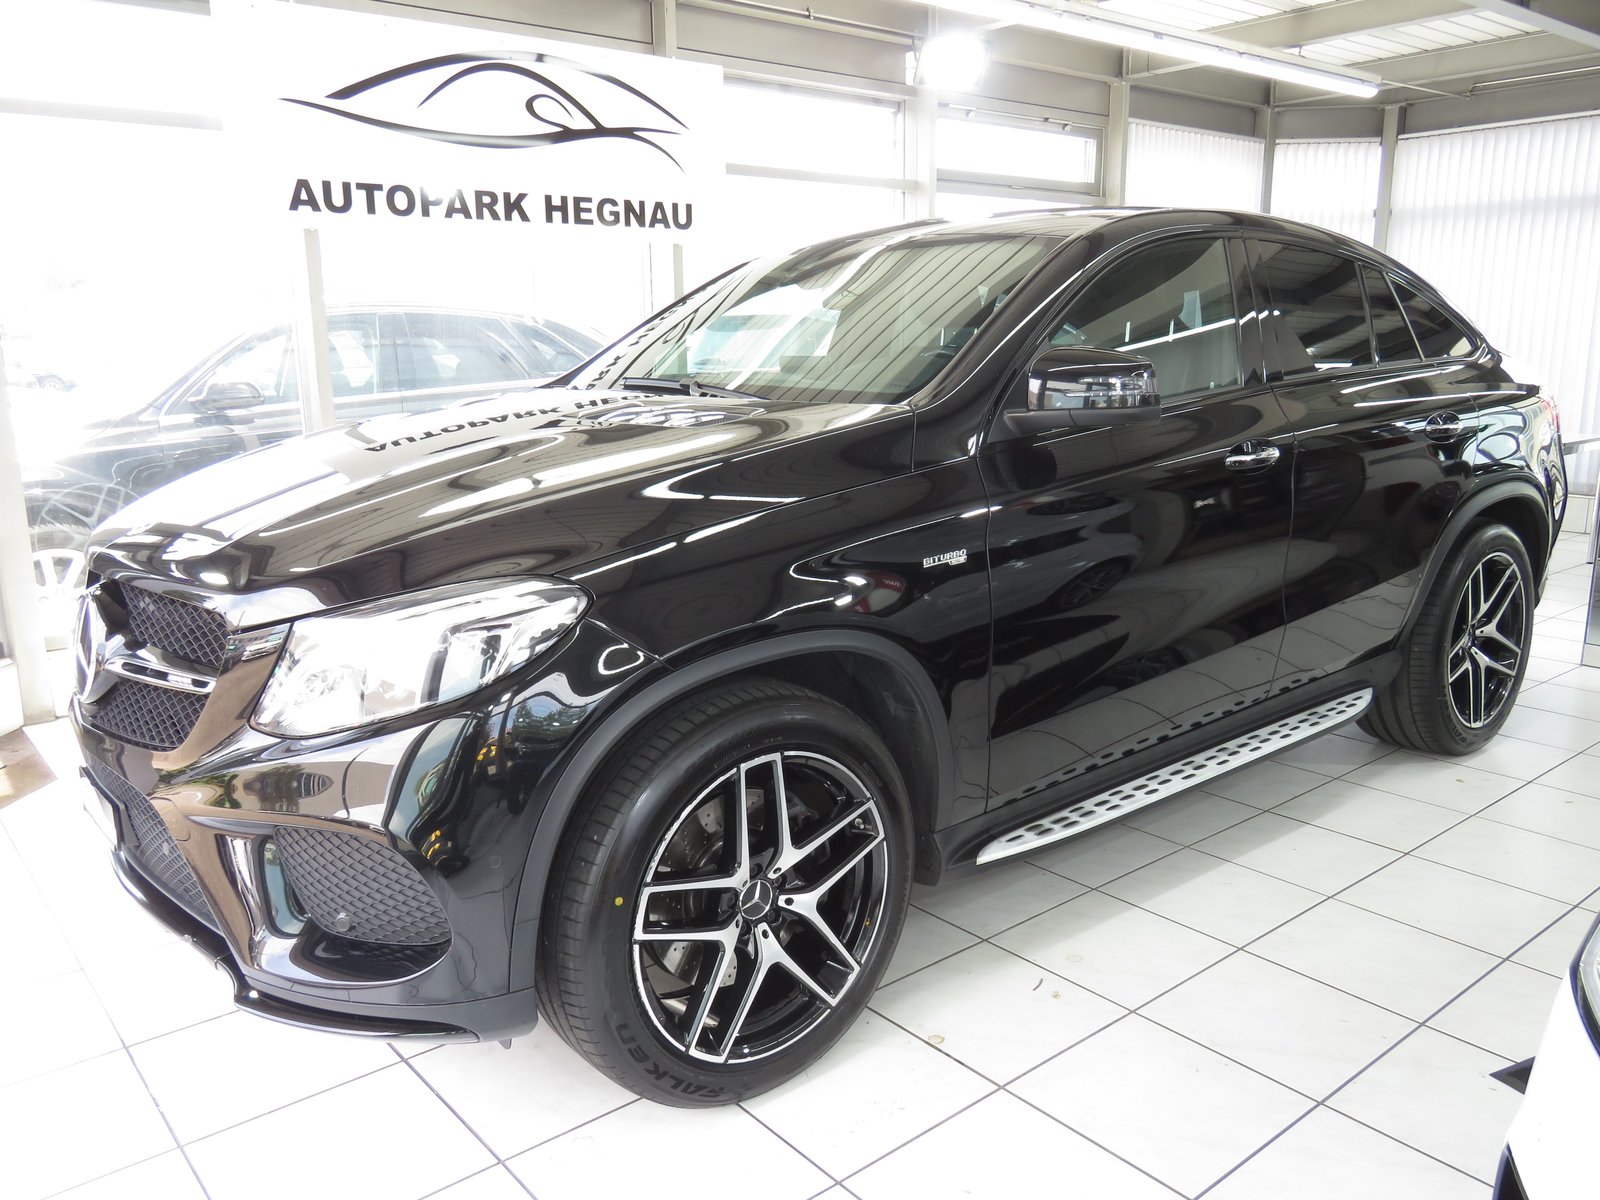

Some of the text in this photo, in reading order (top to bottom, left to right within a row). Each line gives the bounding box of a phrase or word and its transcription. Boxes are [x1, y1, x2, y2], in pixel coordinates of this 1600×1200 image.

[289, 178, 693, 231] AUTOPARK HEGNAU
[922, 548, 968, 566] BITURBO
[615, 1023, 726, 1098] FALKEN
